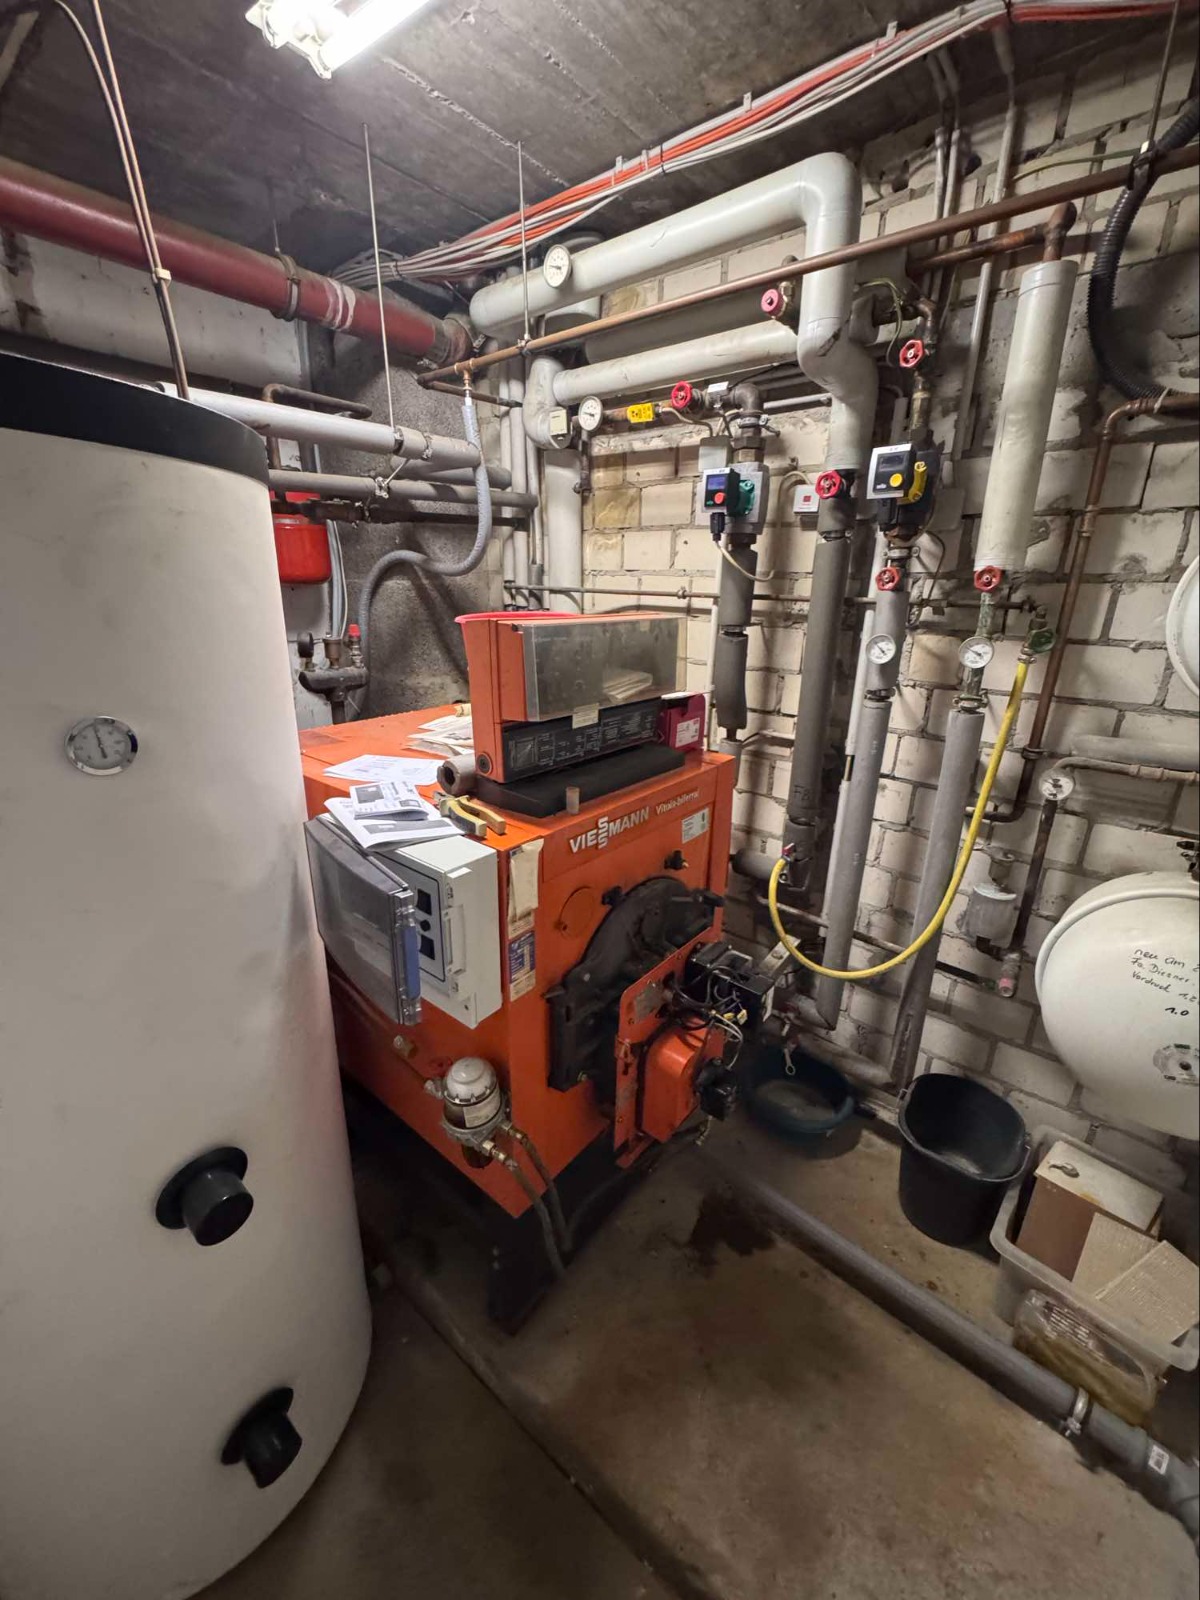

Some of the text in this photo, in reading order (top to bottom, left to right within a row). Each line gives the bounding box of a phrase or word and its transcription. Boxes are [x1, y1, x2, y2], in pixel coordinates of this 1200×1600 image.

[569, 806, 650, 853] VIESSMANN
[1134, 949, 1159, 960] neu
[1132, 970, 1171, 993] Vordruck
[1164, 1006, 1190, 1016] 1.0
